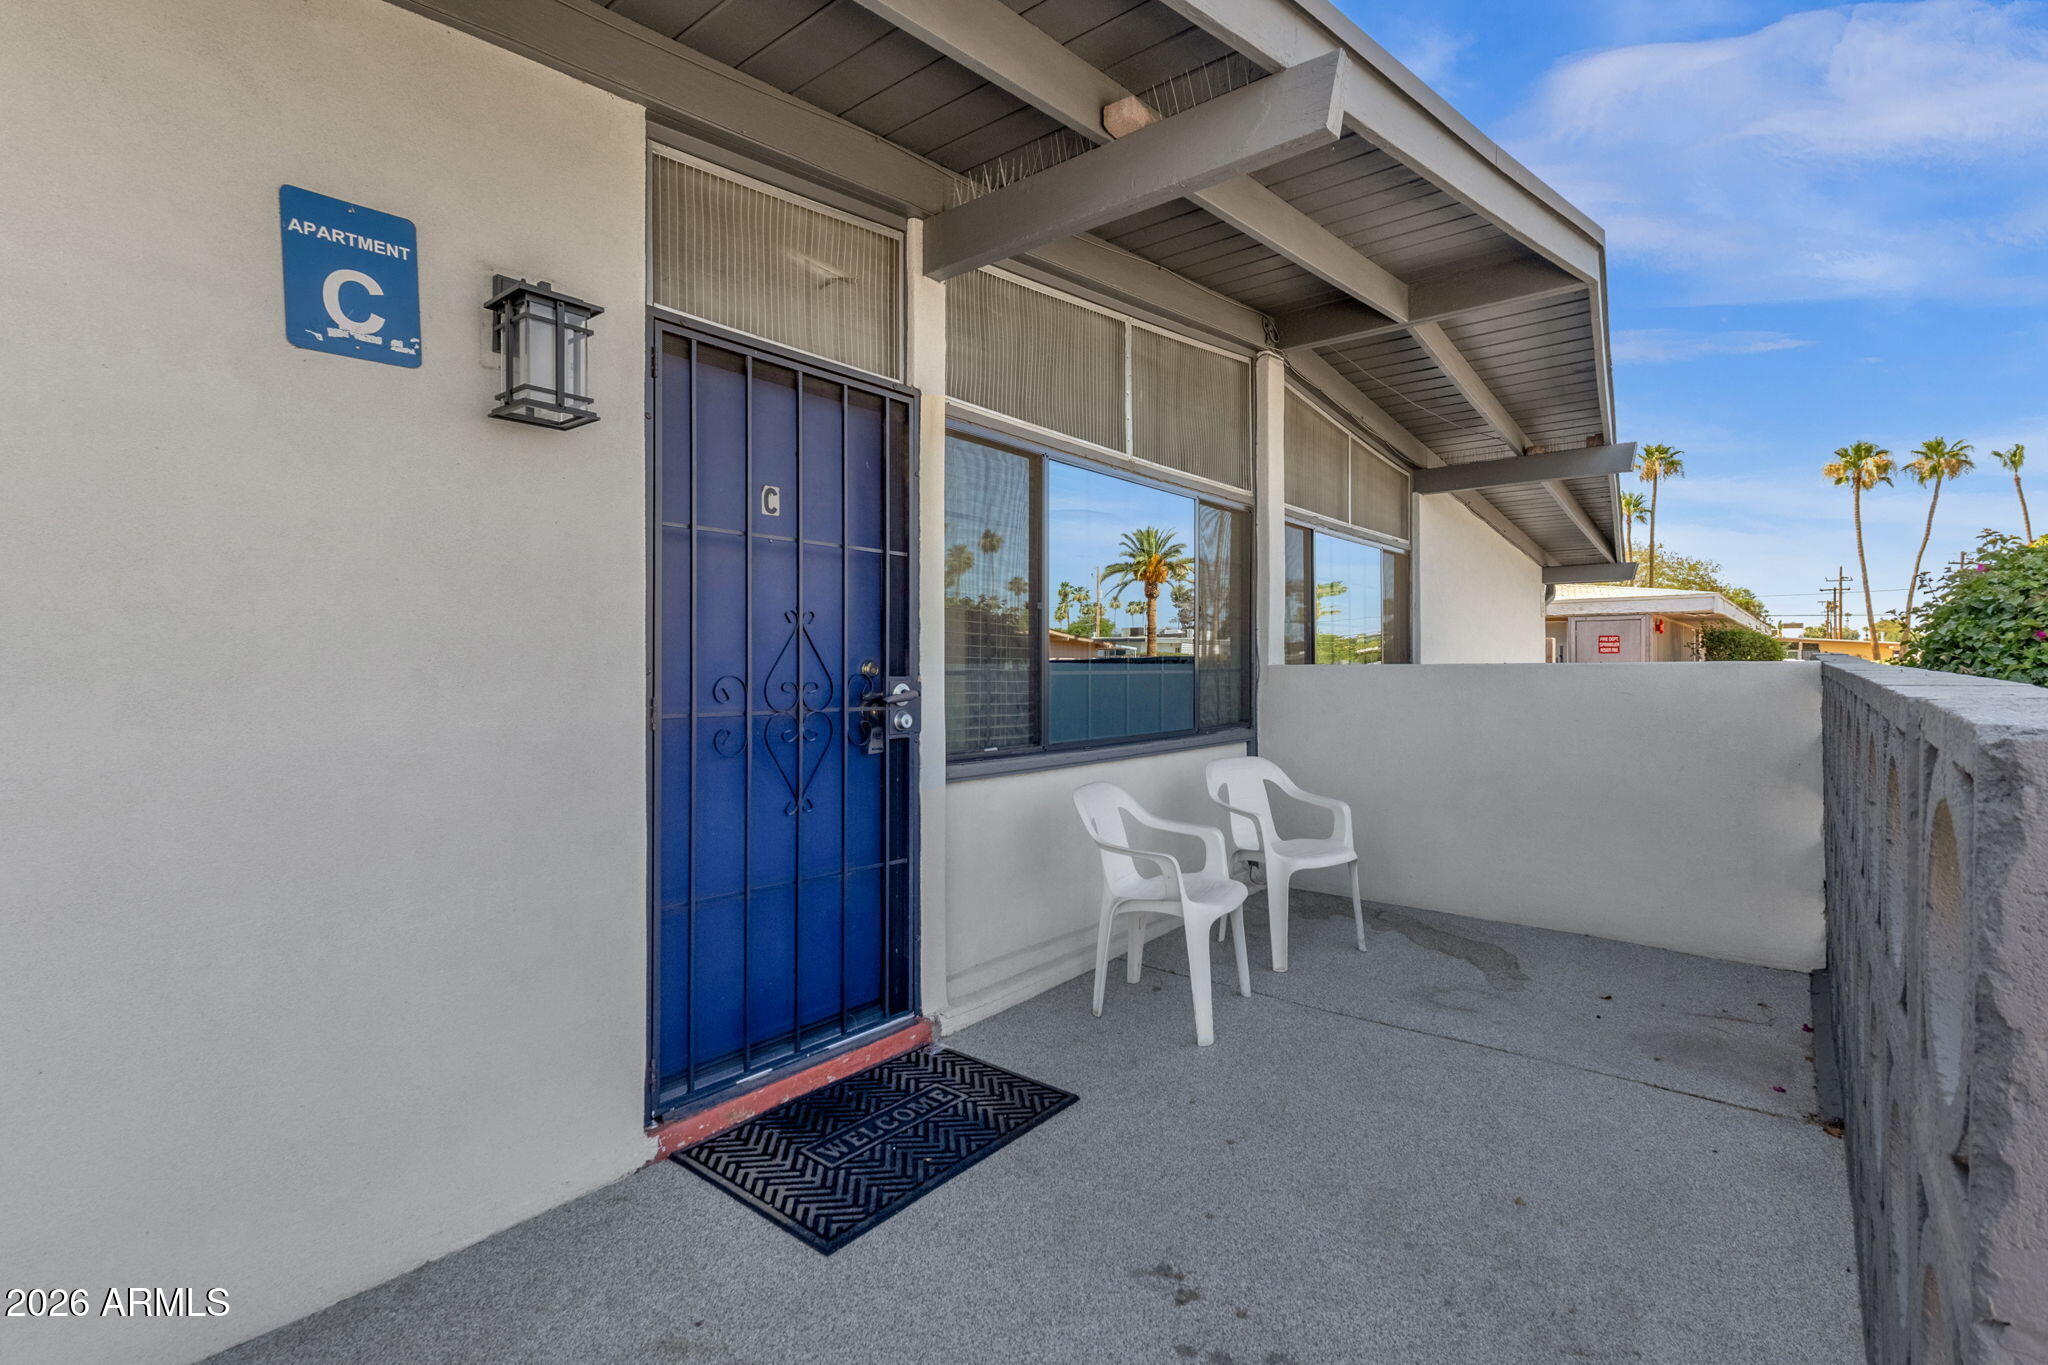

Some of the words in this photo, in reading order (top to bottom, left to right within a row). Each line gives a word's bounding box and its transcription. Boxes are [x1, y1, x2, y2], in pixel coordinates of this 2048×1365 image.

[288, 218, 410, 261] APARTMENT
[323, 269, 386, 335] C
[764, 487, 777, 514] C
[815, 1089, 954, 1157] WELCOME
